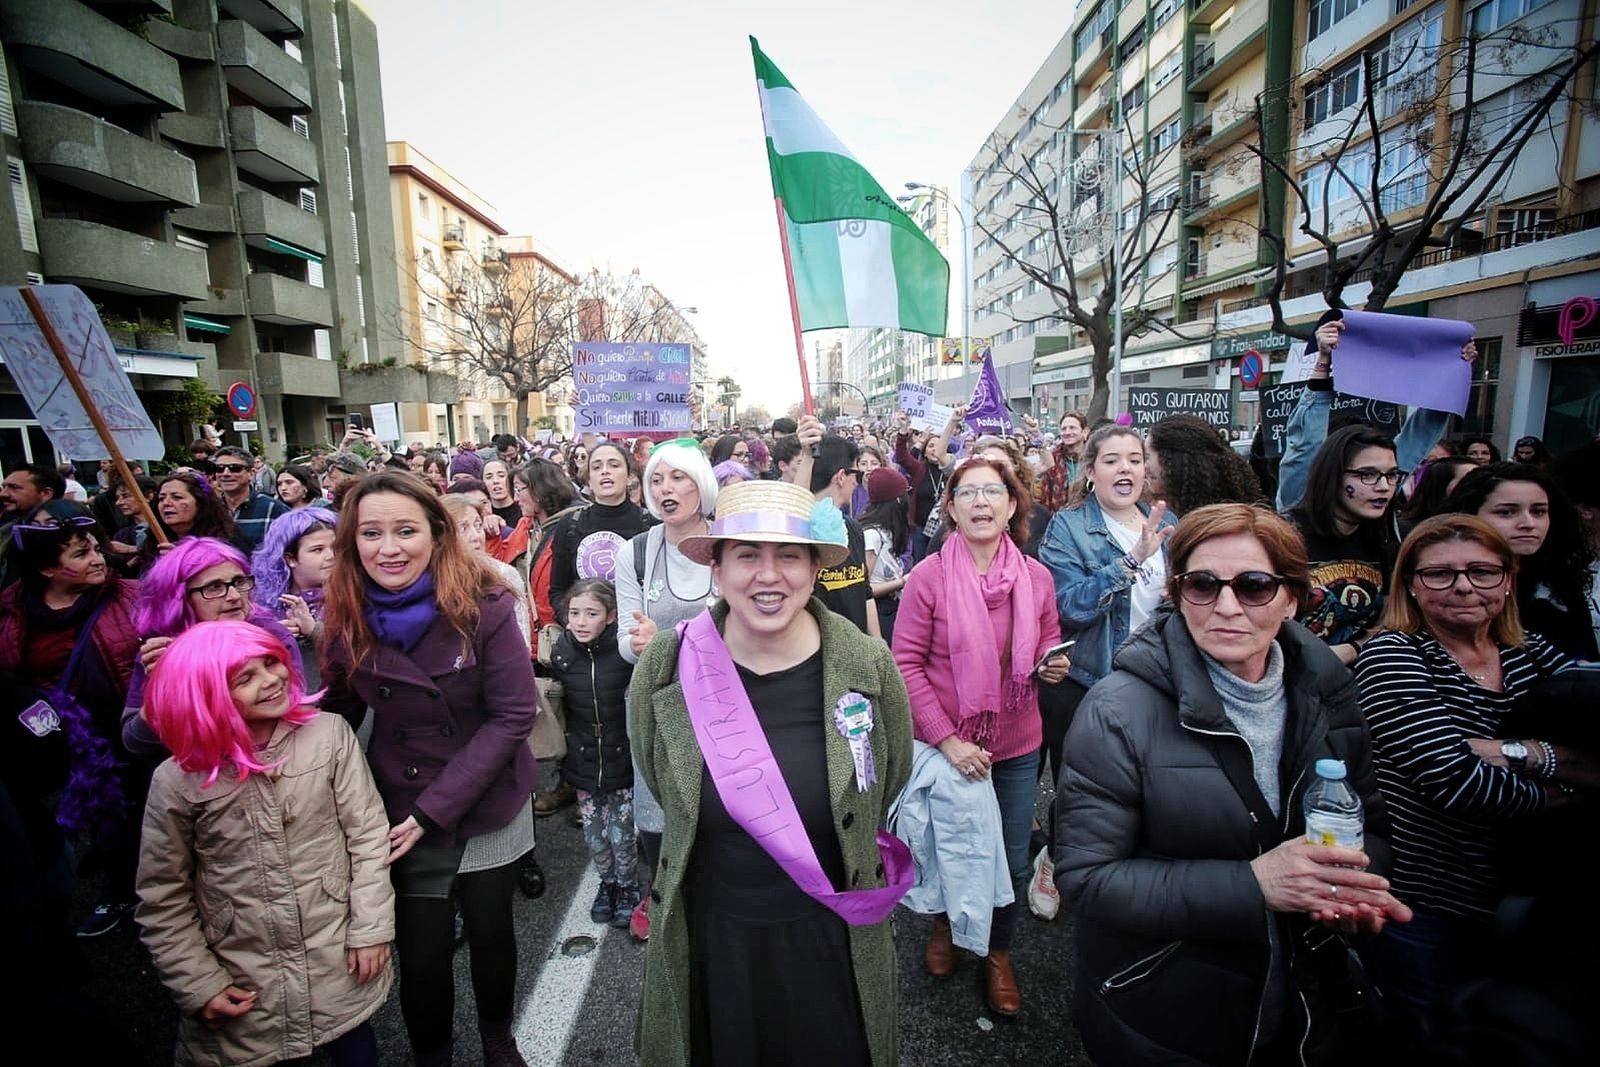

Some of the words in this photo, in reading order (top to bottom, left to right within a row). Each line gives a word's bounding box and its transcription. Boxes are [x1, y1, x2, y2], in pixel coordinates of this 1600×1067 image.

[1231, 332, 1286, 352] Fraternidad
[1536, 341, 1600, 357] FISIOTERAP
[578, 370, 596, 385] No
[597, 370, 626, 388] quiero
[579, 388, 610, 406] Quiero
[656, 392, 686, 403] CALLE
[1132, 392, 1159, 407] NOS
[1166, 392, 1229, 409] QUITARON
[1264, 384, 1305, 403] Todo
[580, 408, 602, 427] Sin
[1208, 411, 1230, 425] NOS
